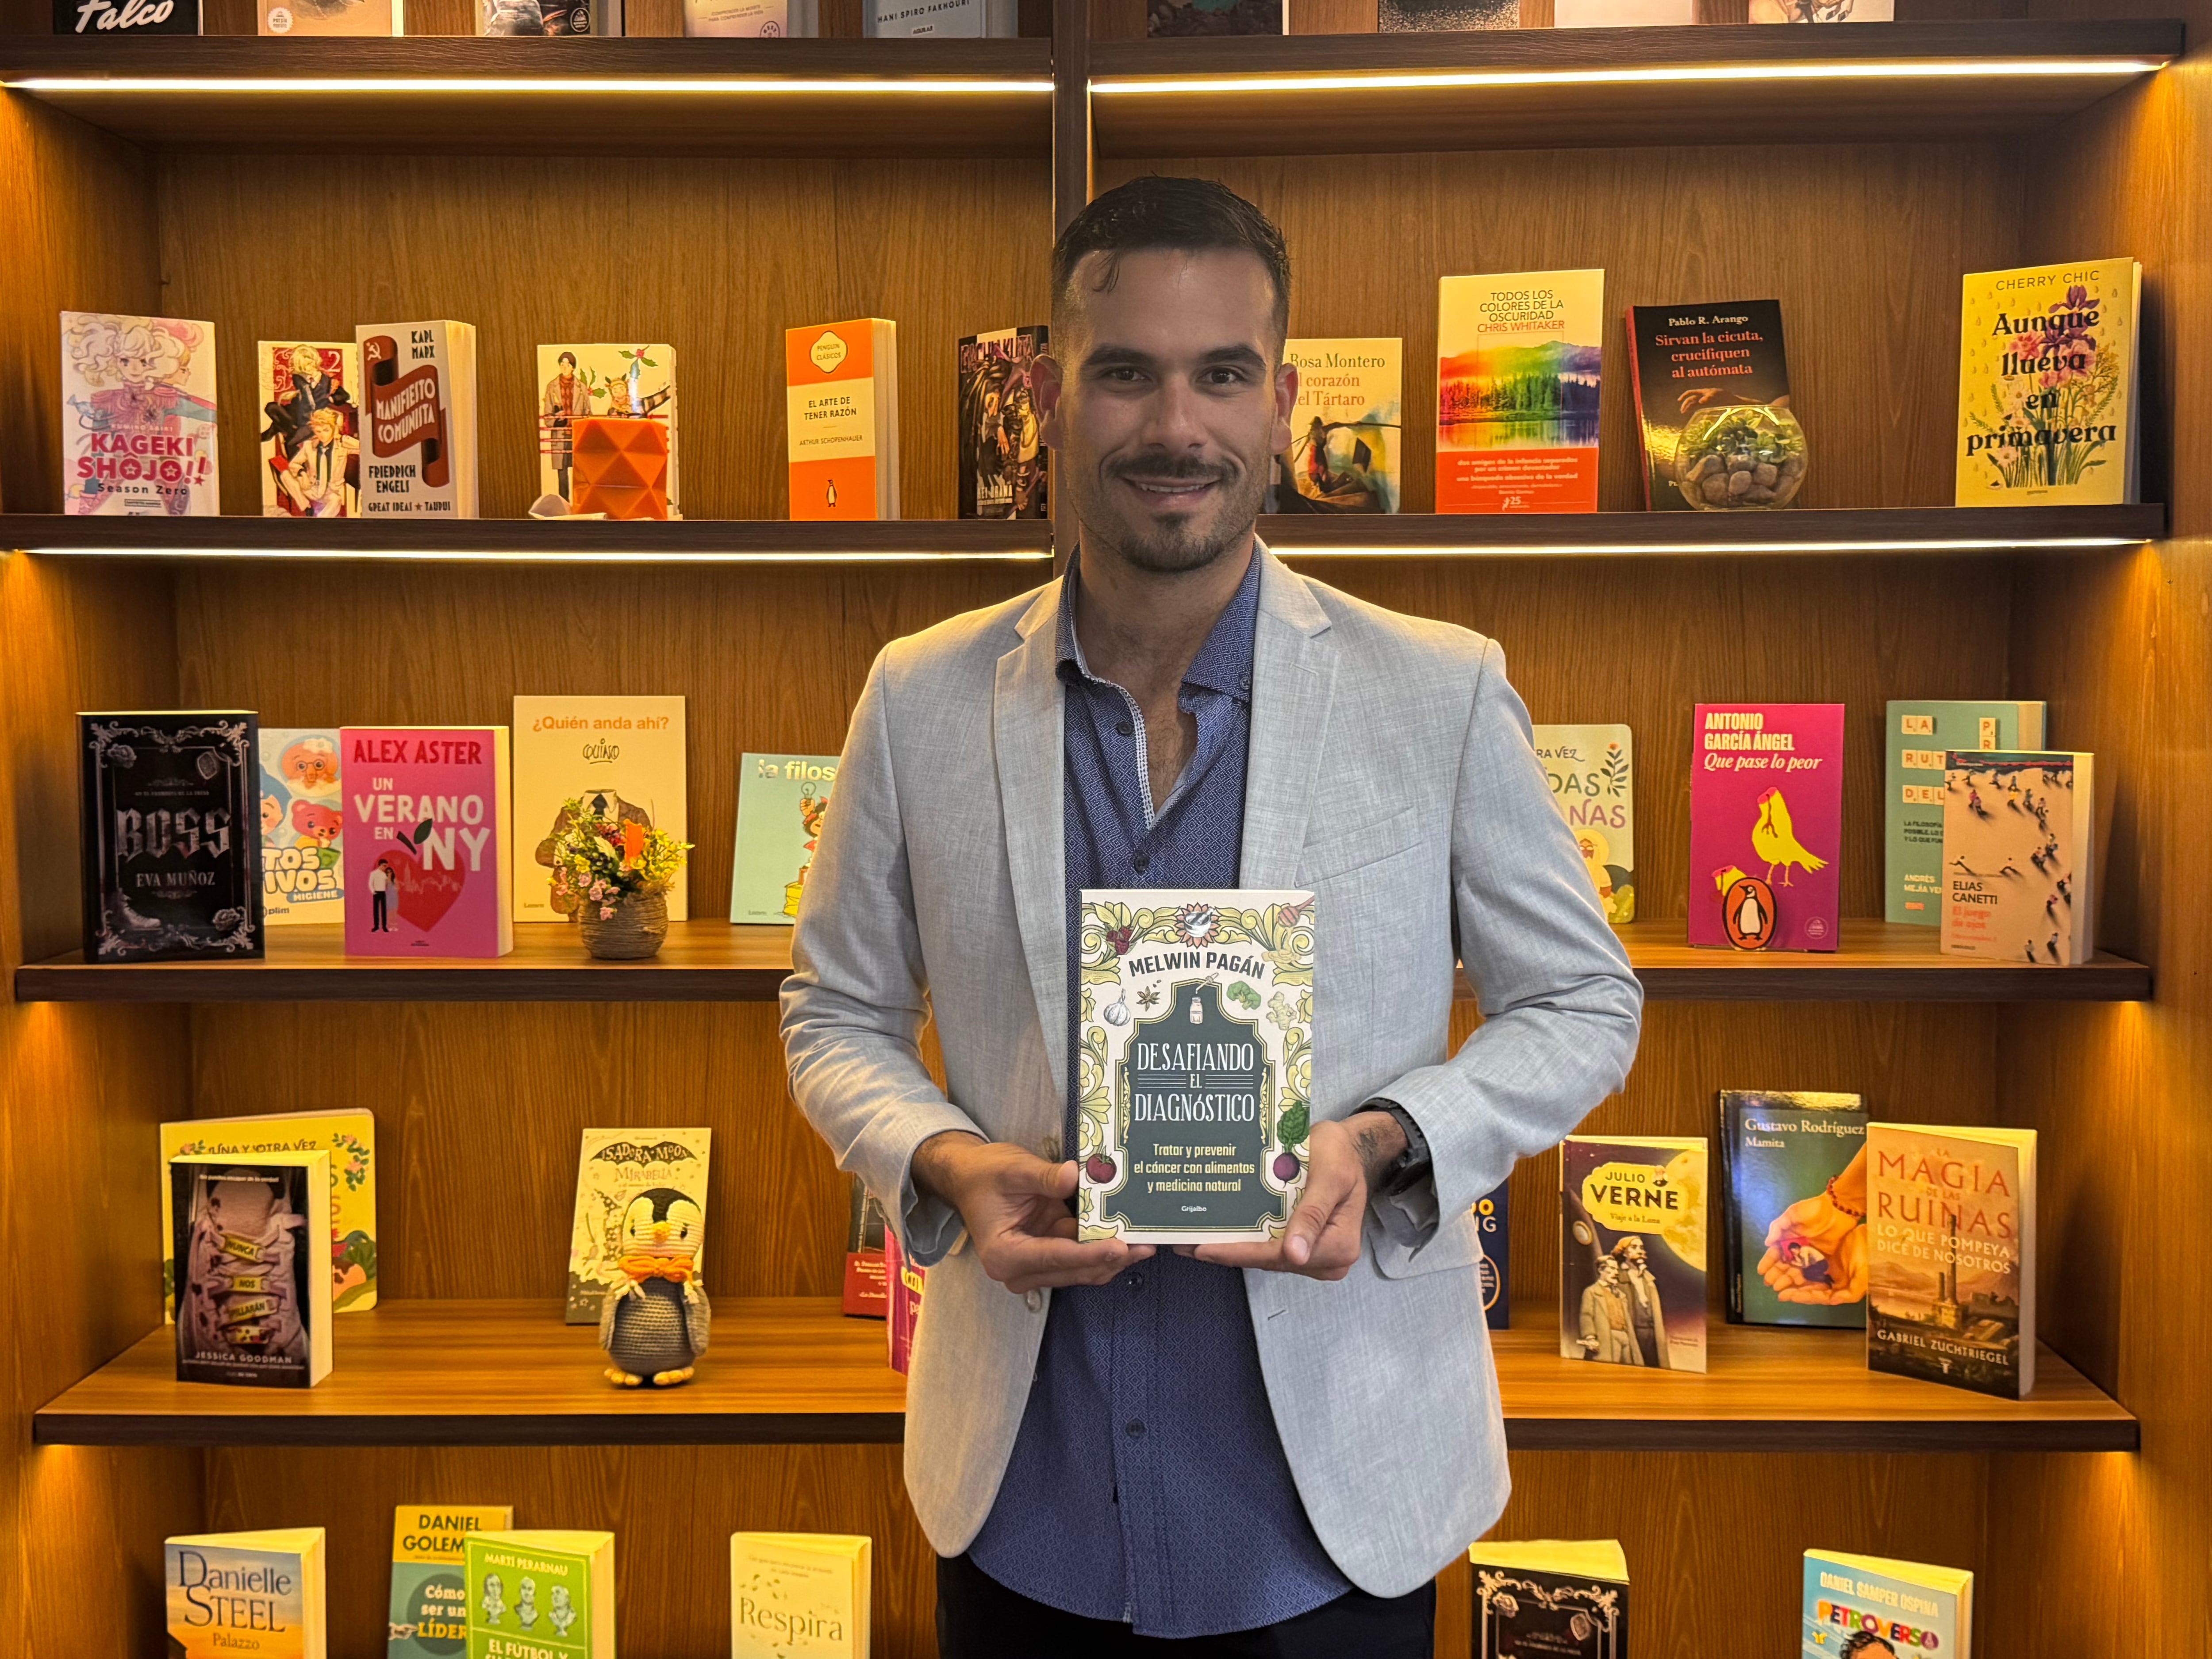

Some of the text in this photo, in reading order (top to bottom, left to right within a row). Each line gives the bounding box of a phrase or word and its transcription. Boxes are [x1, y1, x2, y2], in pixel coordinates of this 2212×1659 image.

[878, 0, 969, 23] HANI SPIRO FAKHOURI
[1996, 271, 2099, 291] CHERRY CHIC
[1491, 290, 1553, 301] TODOS LOS
[1480, 300, 1563, 312] COLORES DE LA
[1490, 311, 1554, 322] OSCURIDAD
[1669, 318, 1696, 326] Pablo
[1712, 315, 1748, 325] Arango
[1992, 311, 2100, 336] Aunque
[1478, 320, 1565, 333] CHRIS WHITAKER
[411, 330, 434, 344] KARL
[1655, 331, 1763, 346] Sirvan la cicuta,
[412, 346, 435, 359] MARX
[1671, 349, 1750, 362] crucifiquen
[326, 351, 341, 372] 2
[1290, 353, 1385, 368] Rosa Montero
[2002, 353, 2085, 376] llueva
[1672, 365, 1753, 378] al autómata
[1306, 374, 1359, 387] corazón
[376, 378, 435, 420] MANIFIESTO
[819, 398, 838, 407] ARTE
[1313, 391, 1365, 405] Tártaro
[2027, 391, 2058, 410] en
[804, 406, 856, 420] TENER RAZÓN
[378, 403, 434, 443] COMUNISTA
[91, 433, 193, 457] KAGEKI
[821, 435, 863, 444] SCHOPENHAUER
[1966, 425, 2116, 457] primavera
[369, 465, 416, 478] FRIEDRICH
[98, 484, 187, 495] Season Zero
[376, 480, 409, 493] ENGELS
[369, 502, 450, 511] GREAT IDEAS TAURUS
[533, 716, 669, 732] ¿Quién anda ahí?
[1705, 713, 1763, 730] ANTONIO
[1905, 720, 1929, 730] LA
[1705, 731, 1794, 751] GARCÍA ÁNGEL
[354, 740, 482, 764] ALEX ASTER
[1555, 746, 1585, 762] VEZ
[1906, 753, 1943, 764] RUT
[758, 759, 836, 781] la filos
[1704, 753, 1822, 772] Que pase lo peor
[373, 778, 393, 791] UN
[1905, 788, 1944, 800] DEL
[354, 795, 484, 824] VERANO
[117, 808, 230, 863] BOSS
[375, 827, 490, 871] EN NY
[137, 871, 215, 885] EVA MUÑOZ
[1953, 881, 1983, 891] ELIAS
[294, 891, 337, 901] HIGIENE
[1953, 893, 1997, 904] CANETTI
[1128, 952, 1265, 979] MELWIN PAGÁN
[1137, 1043, 1254, 1071] DESAFIANDO
[1190, 1074, 1202, 1088] EL
[1134, 1093, 1255, 1121] DIAGNÓSTICO
[1745, 1118, 1866, 1137] Gustavo Rodríguez
[1745, 1137, 1785, 1148] Mamita
[1153, 1144, 1236, 1158] Tratar y prevenir
[1134, 1161, 1255, 1174] el cáncer con alimentos
[1878, 1151, 2011, 1197] MAGIA
[1605, 1172, 1645, 1183] JULIO
[1148, 1179, 1241, 1194] y medicina natural
[1927, 1187, 1960, 1200] DE LAS
[1590, 1184, 1679, 1210] VERNE
[1878, 1192, 2011, 1239] RUINAS
[227, 1242, 254, 1255] NUNCA
[1877, 1223, 2011, 1259] LO QUE POMPEYA
[1877, 1239, 2011, 1275] DICE DE NOSOTROS
[239, 1280, 255, 1288] NOS
[1877, 1329, 2008, 1366] GABRIEL ZUCHTRIEGEL
[196, 1352, 292, 1363] JESSICA GOODMAN
[419, 1514, 482, 1532] DANIEL
[485, 1552, 568, 1576] MARTÍ PERARNAU
[179, 1551, 292, 1596] Danielle
[425, 1584, 465, 1600] Cómo
[1820, 1571, 1939, 1617] DANIEL SAMPER OSPINA
[184, 1585, 285, 1632] STEEL
[421, 1604, 465, 1617] ser un
[740, 1597, 842, 1643] Respira
[1817, 1599, 1939, 1650] PETROVERSO
[213, 1632, 260, 1650] Palazzo
[489, 1639, 503, 1654] EL
